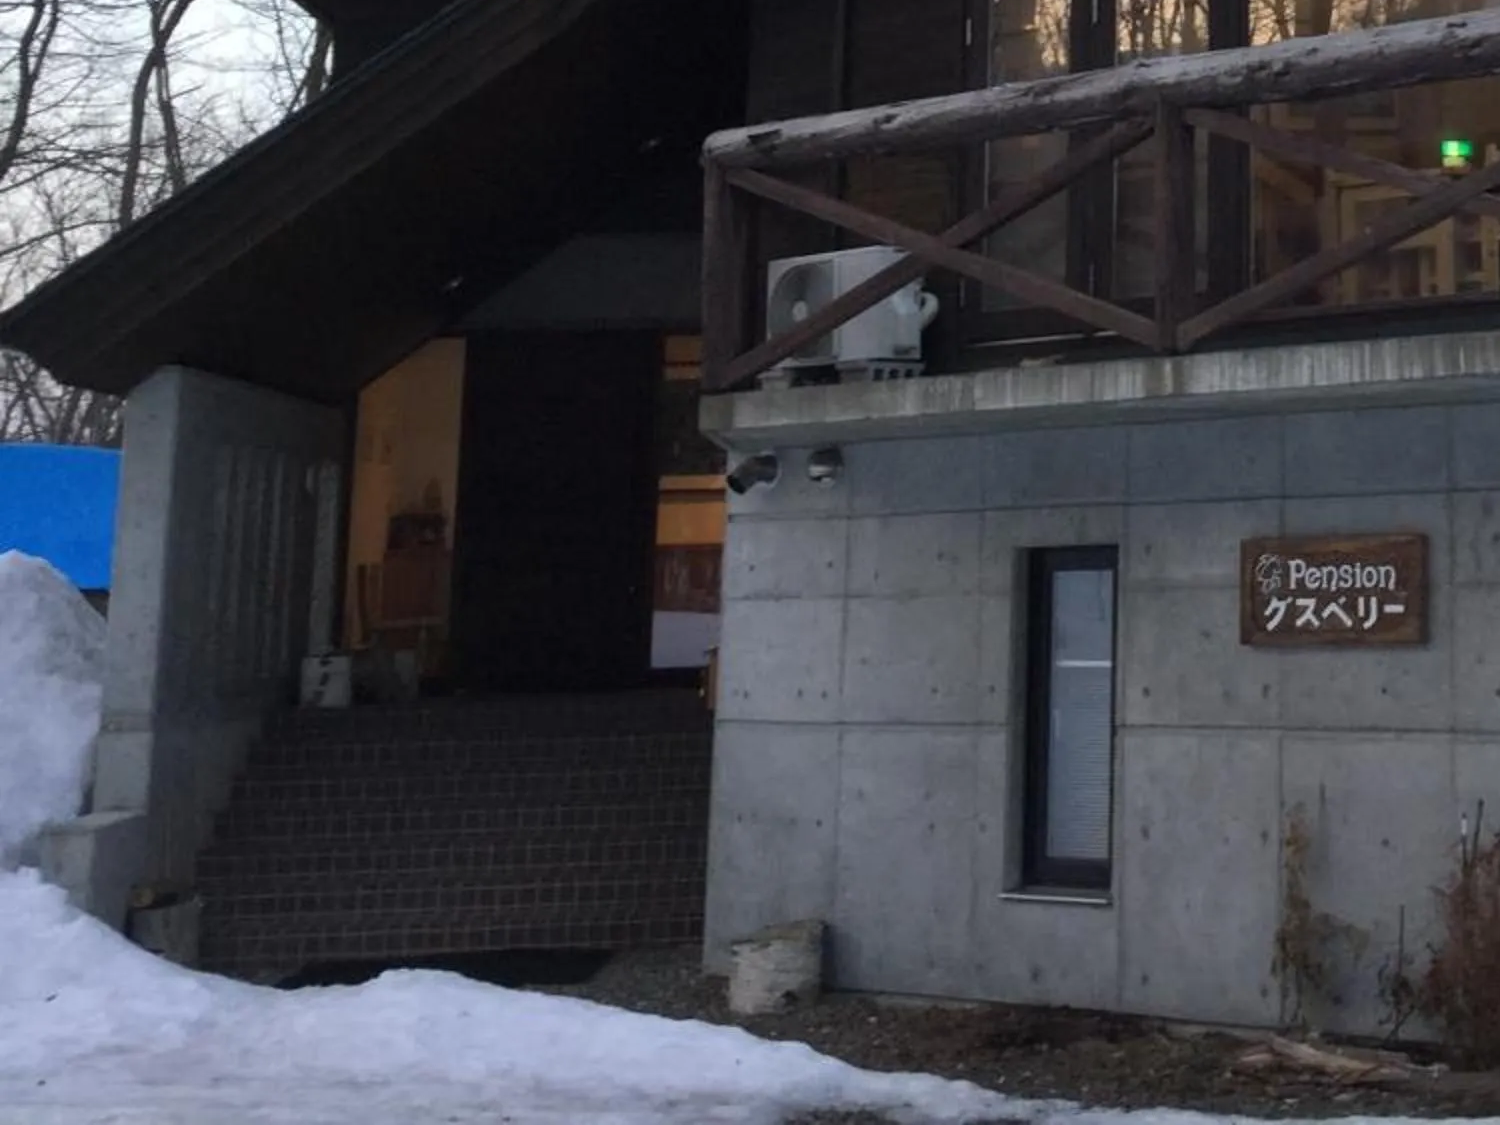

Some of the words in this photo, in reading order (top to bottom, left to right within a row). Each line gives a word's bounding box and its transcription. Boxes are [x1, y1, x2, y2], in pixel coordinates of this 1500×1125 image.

[1288, 558, 1397, 592] Pension
[1264, 596, 1405, 632] グスベリー
